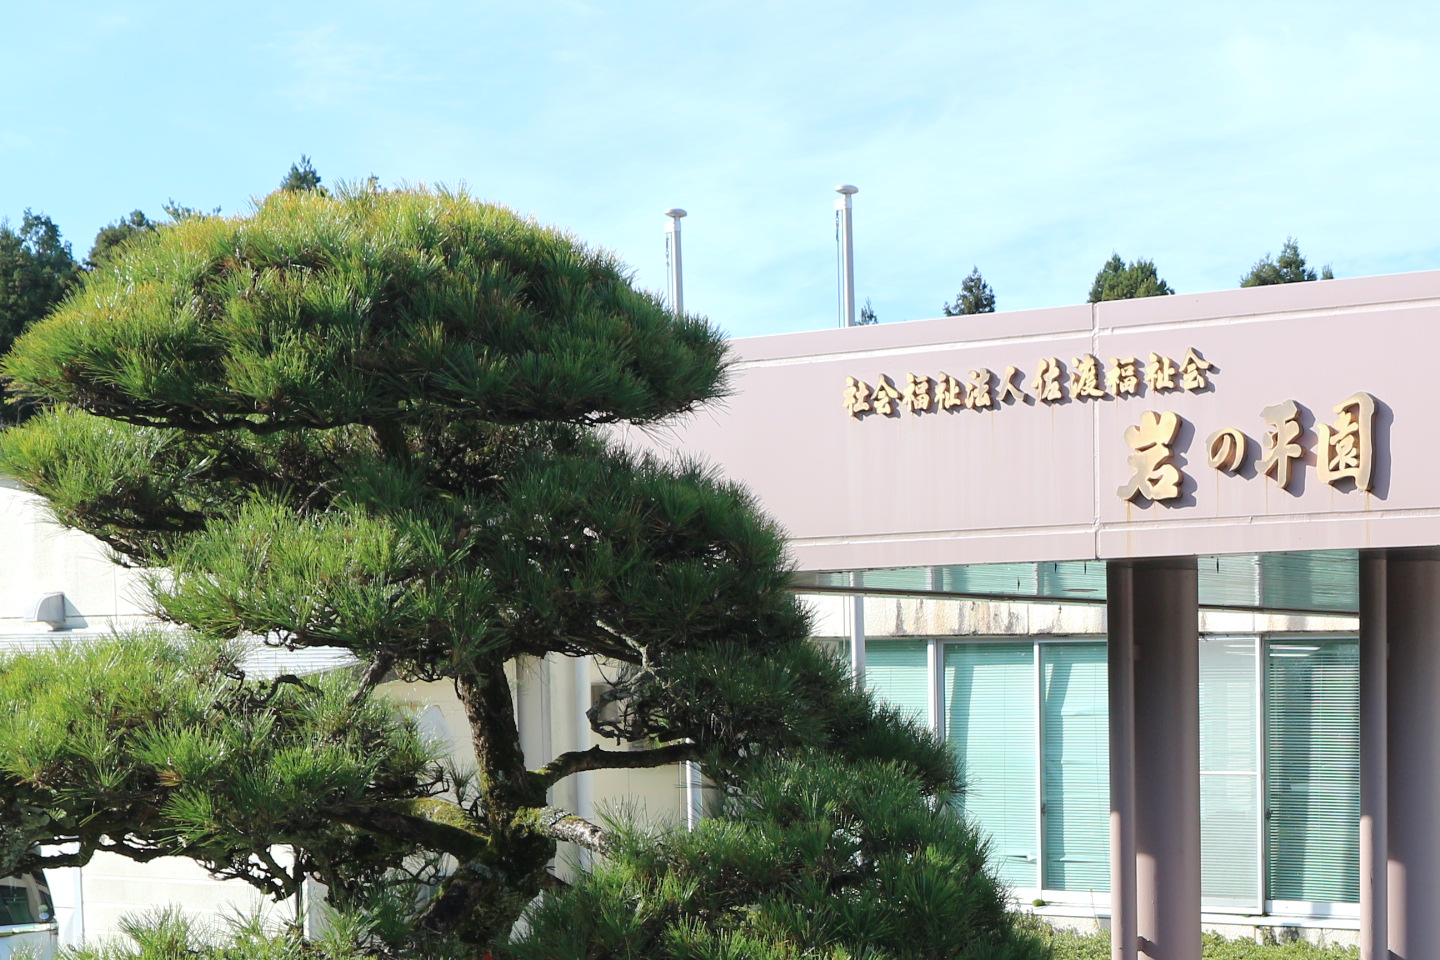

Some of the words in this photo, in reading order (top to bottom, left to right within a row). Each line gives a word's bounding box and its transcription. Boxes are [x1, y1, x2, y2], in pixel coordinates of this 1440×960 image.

[842, 347, 1210, 416] 社会福祉法人佐渡福祉会
[1117, 391, 1378, 502] 岩の平園
